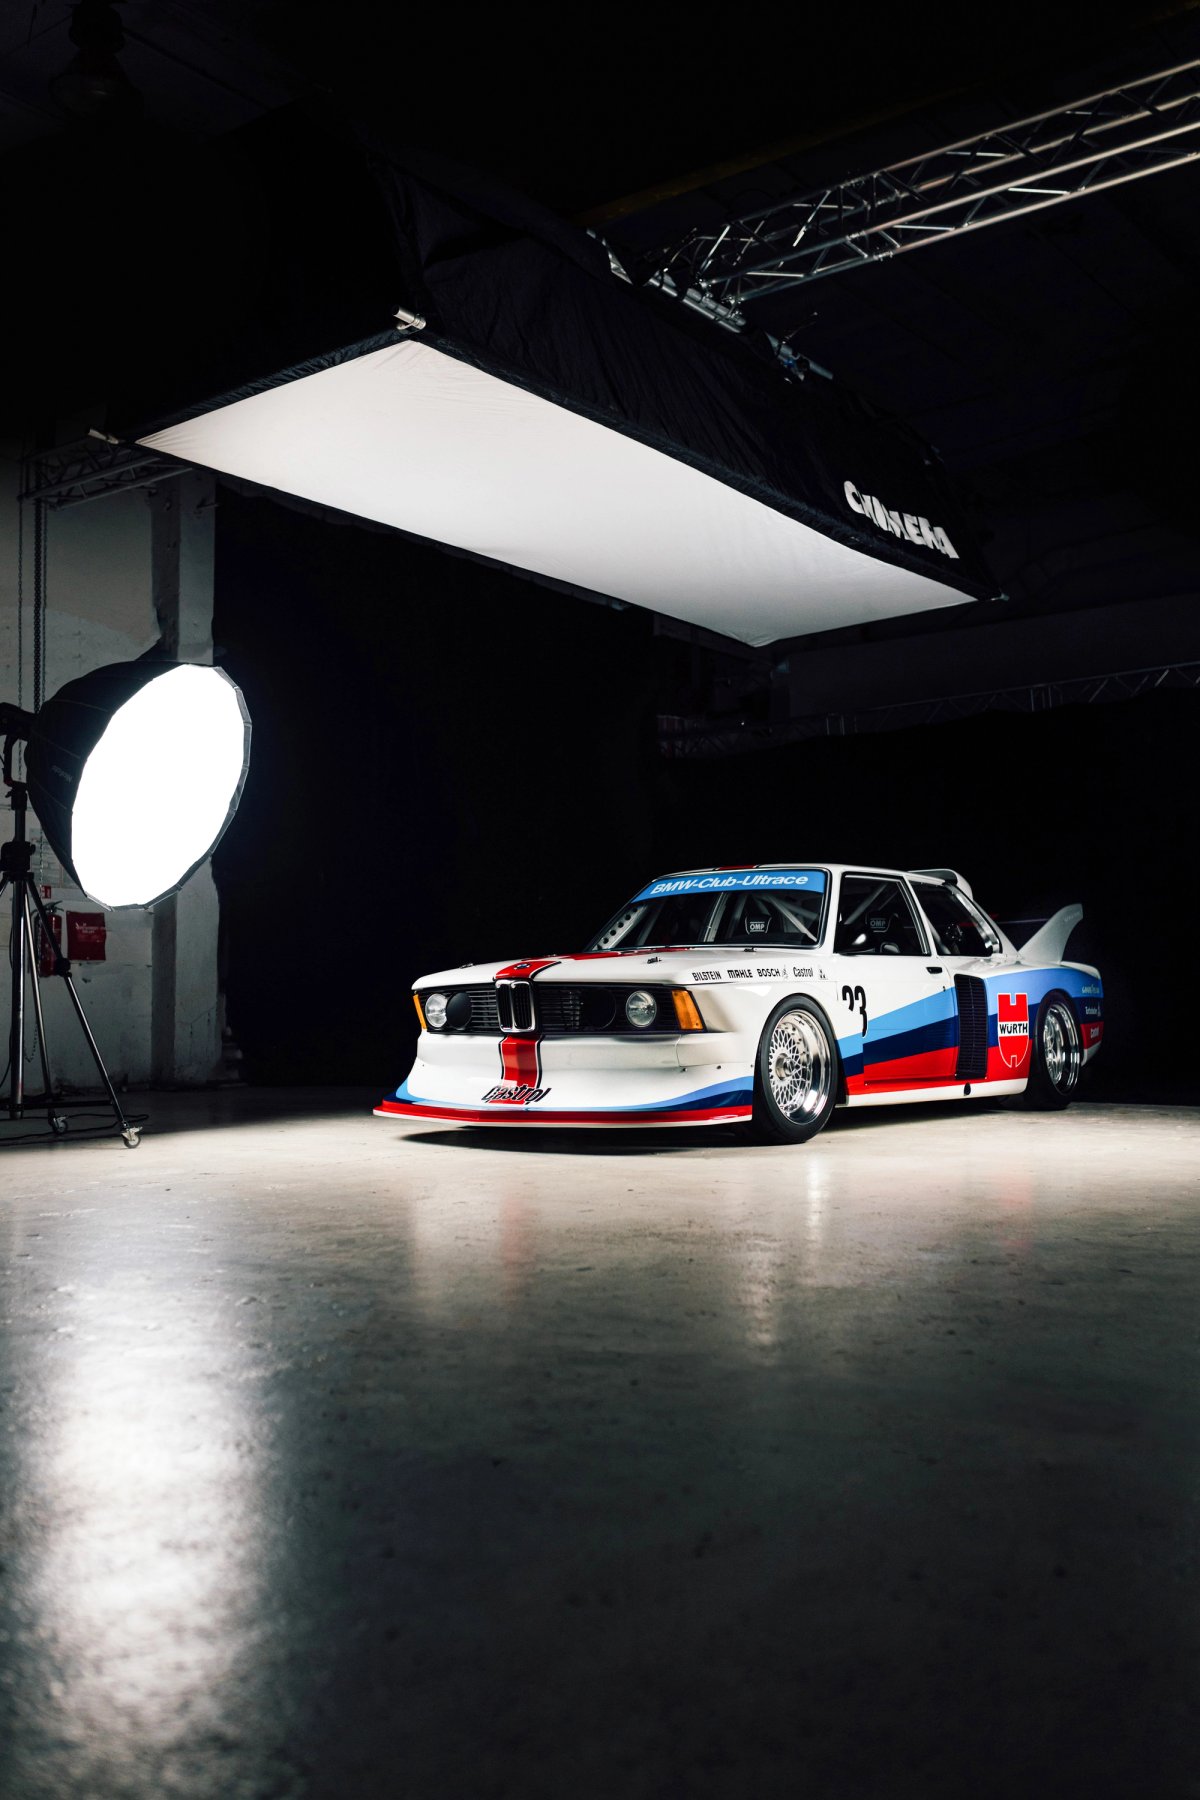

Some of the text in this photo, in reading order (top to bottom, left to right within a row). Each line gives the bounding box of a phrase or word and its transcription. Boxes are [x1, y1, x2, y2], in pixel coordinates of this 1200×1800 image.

[650, 874, 809, 895] BMW-Club-Ultrace
[692, 970, 722, 981] BILSTEIN
[727, 969, 753, 979] MAHLE
[756, 968, 781, 978] BOSCH
[793, 966, 814, 978] Castrol
[481, 1084, 552, 1105] Castrol
